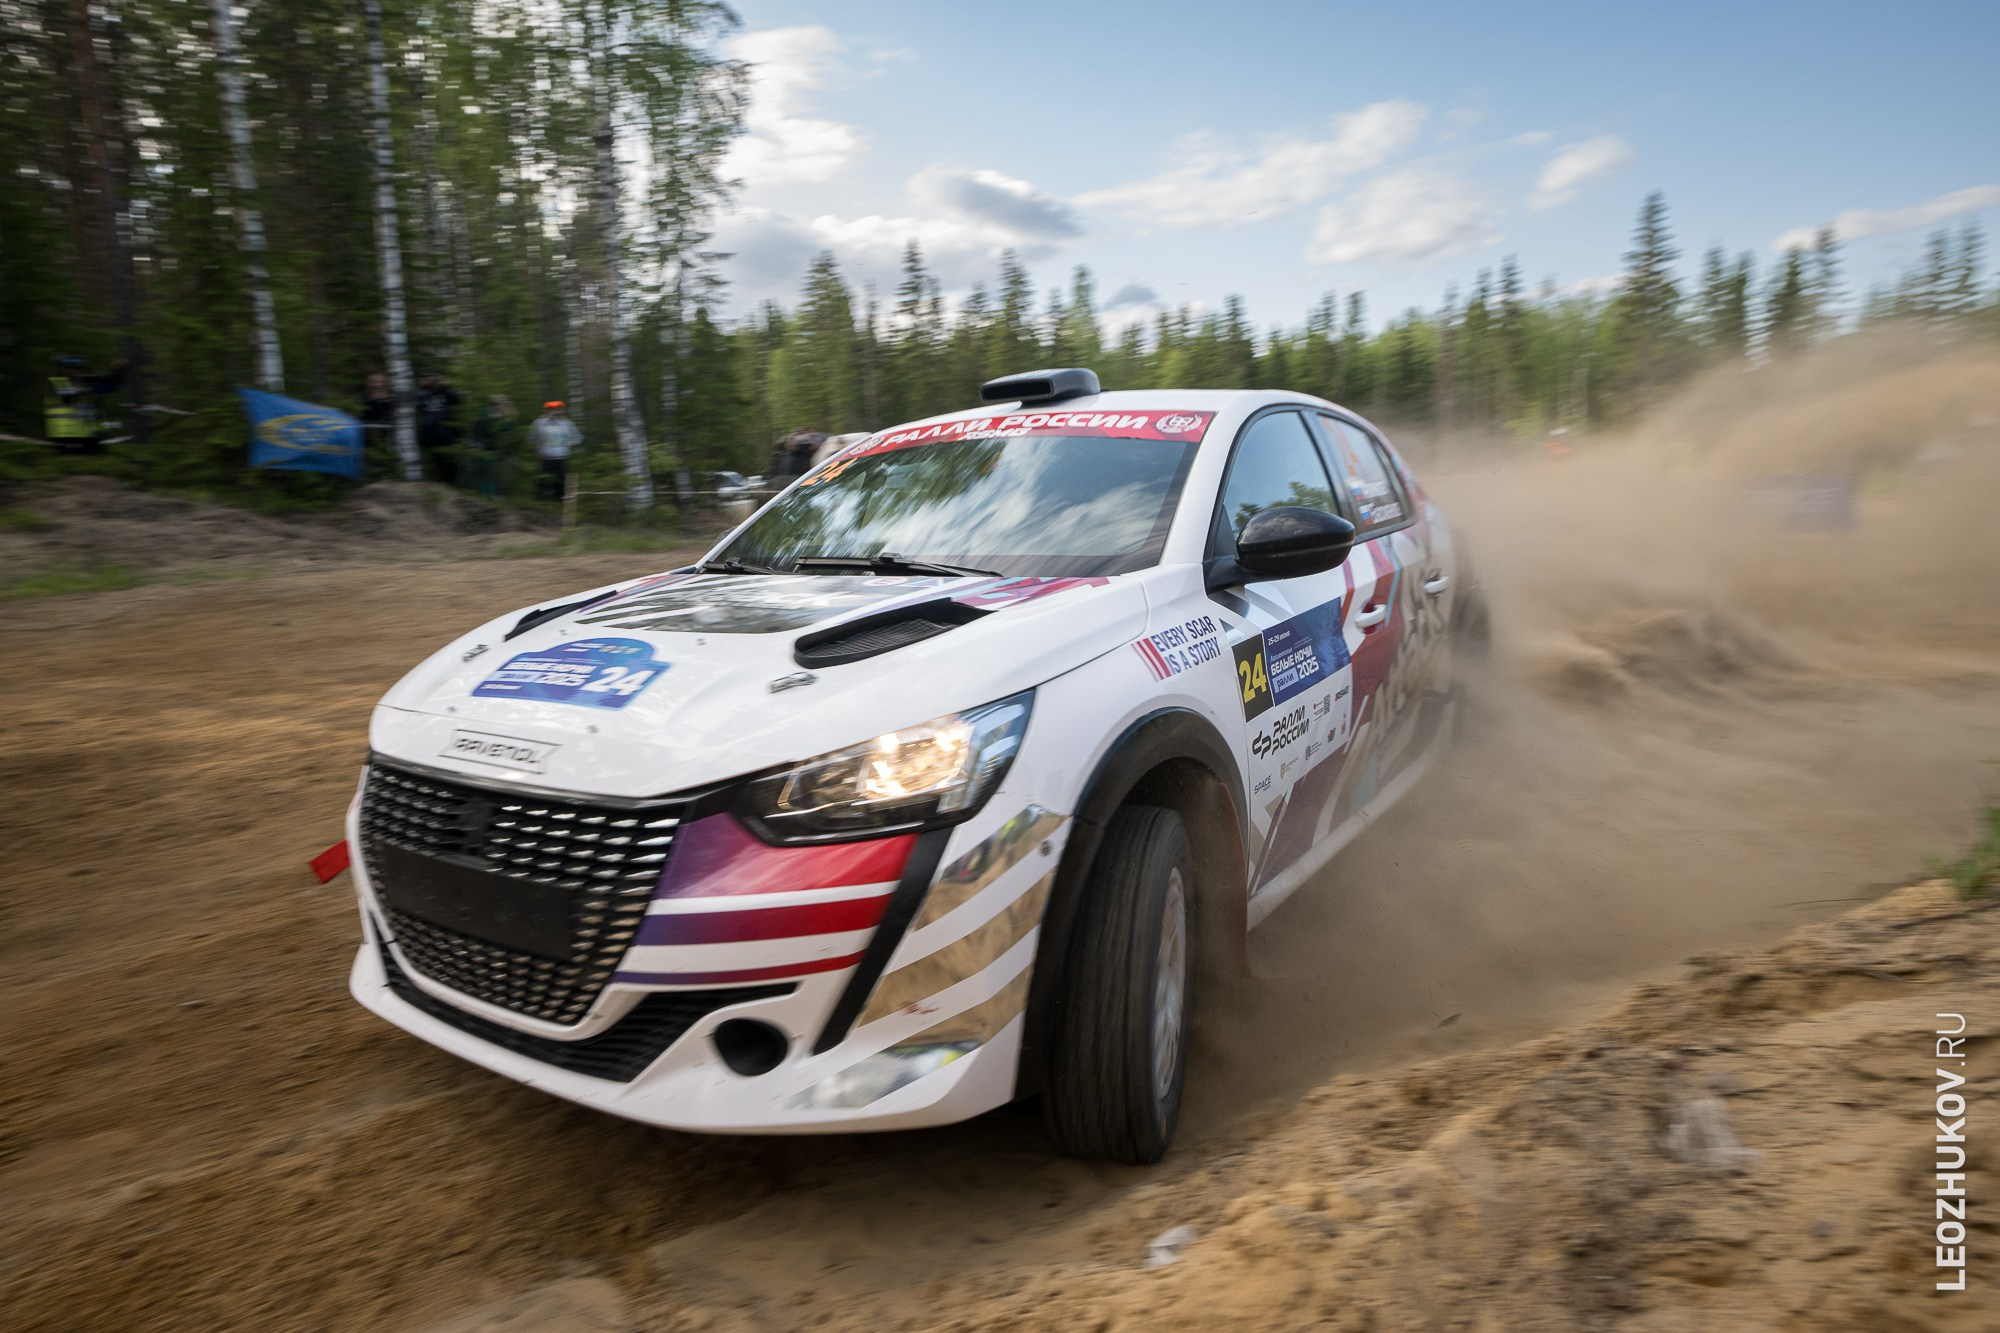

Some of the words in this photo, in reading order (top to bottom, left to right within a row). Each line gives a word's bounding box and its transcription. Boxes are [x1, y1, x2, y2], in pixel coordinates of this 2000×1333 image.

[881, 417, 993, 447] РАЛЛИ
[998, 412, 1150, 429] РОССИИ
[1150, 624, 1189, 652] EVERY
[1185, 615, 1217, 640] SCAR
[1164, 653, 1182, 675] IS
[1179, 650, 1192, 670] A
[1188, 636, 1221, 666] STORY
[1271, 653, 1295, 676] БЕЛЫЕ
[1294, 645, 1313, 664] НОЧИ
[1297, 656, 1320, 680] 2025
[579, 666, 656, 697] 24
[1238, 652, 1267, 704] 24
[1271, 718, 1310, 756] РОССИИ
[1273, 704, 1305, 739] РАЛЛИ
[1254, 775, 1272, 795] SPACE
